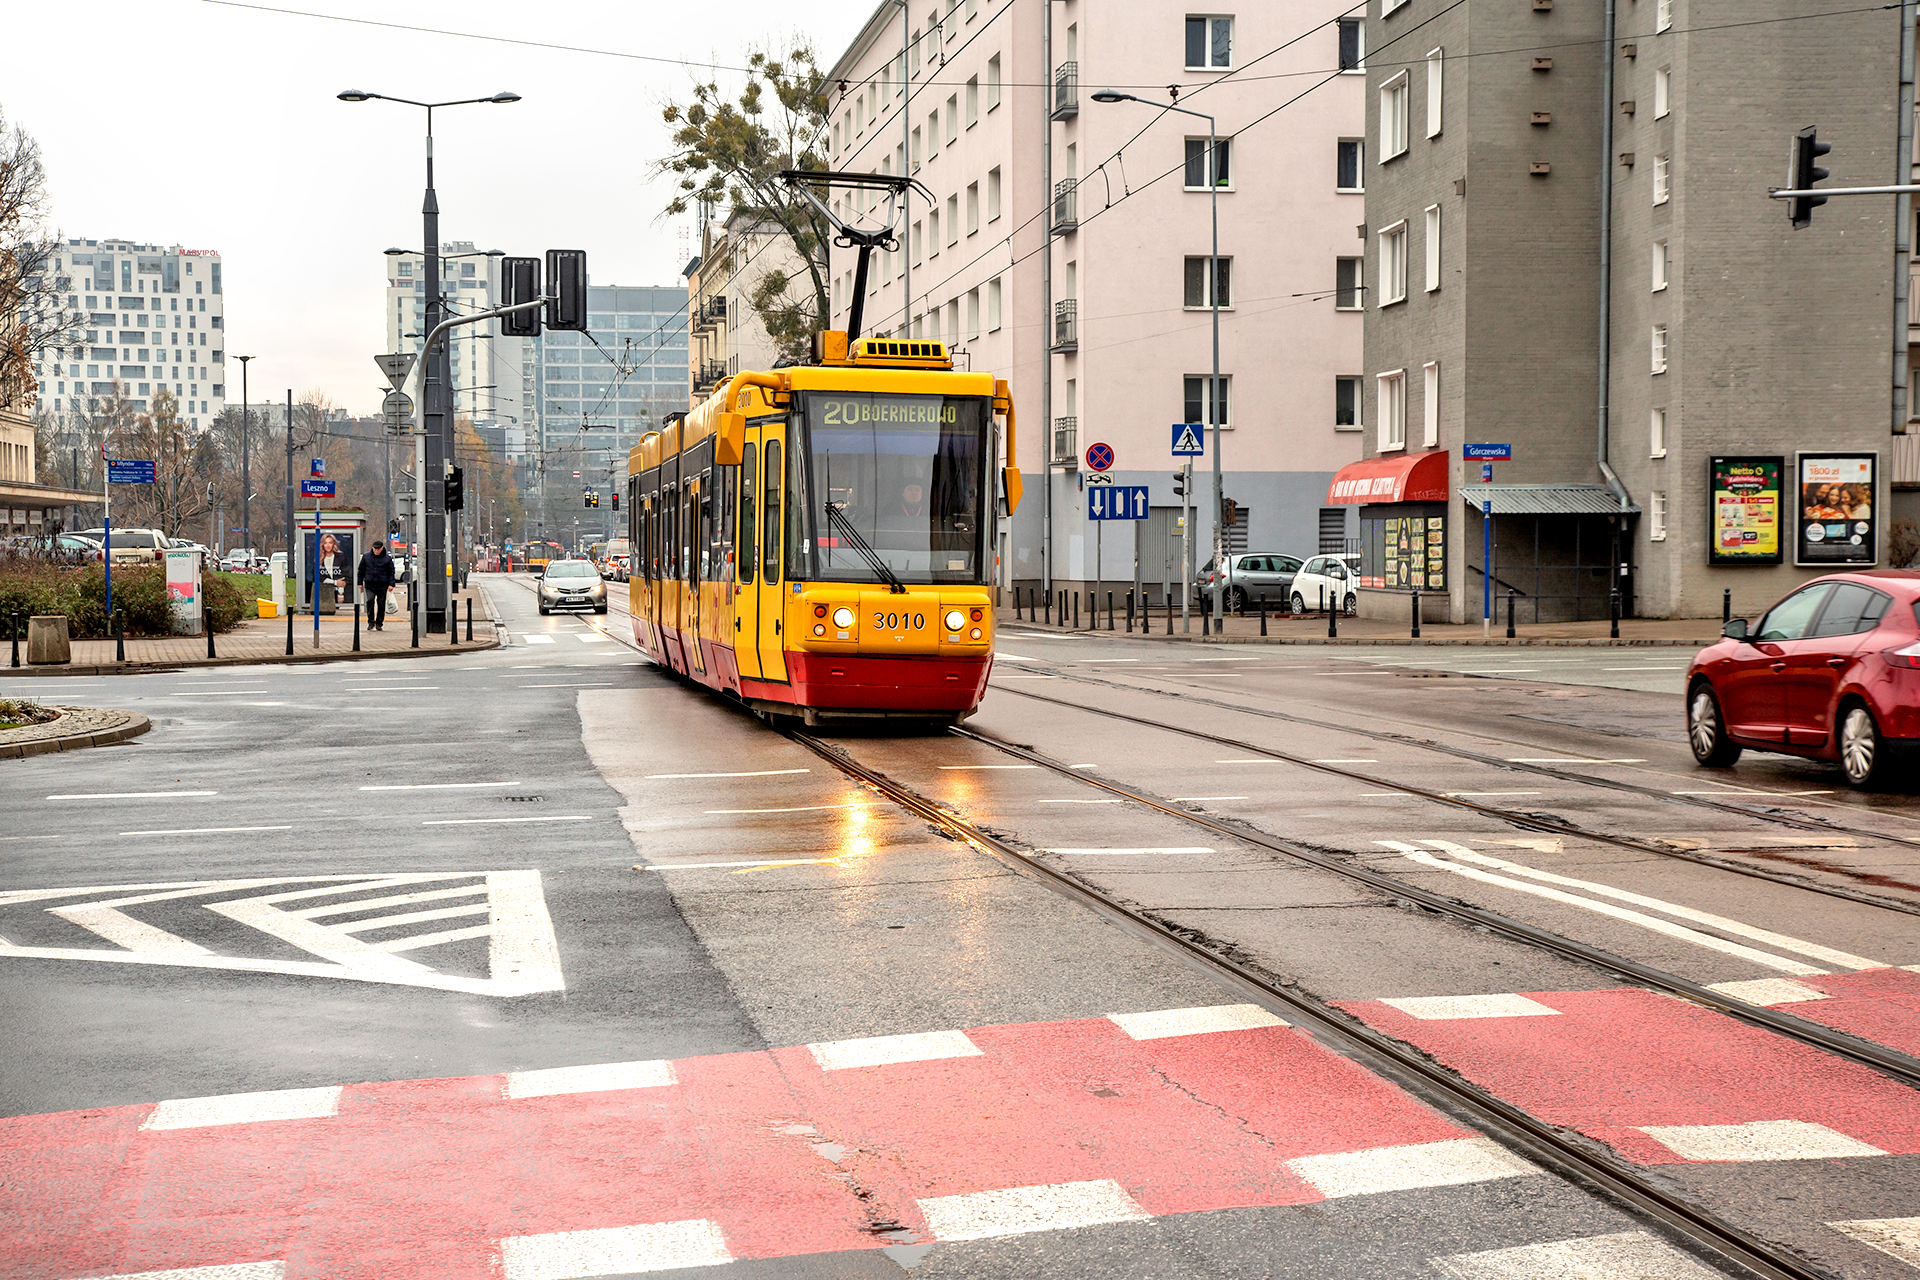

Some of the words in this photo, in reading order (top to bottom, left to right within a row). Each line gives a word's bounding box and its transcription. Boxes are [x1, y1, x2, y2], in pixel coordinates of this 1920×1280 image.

[738, 392, 750, 409] 3010
[824, 402, 860, 424] 20
[862, 404, 956, 424] BOERNEROWO
[873, 612, 925, 630] 3010
